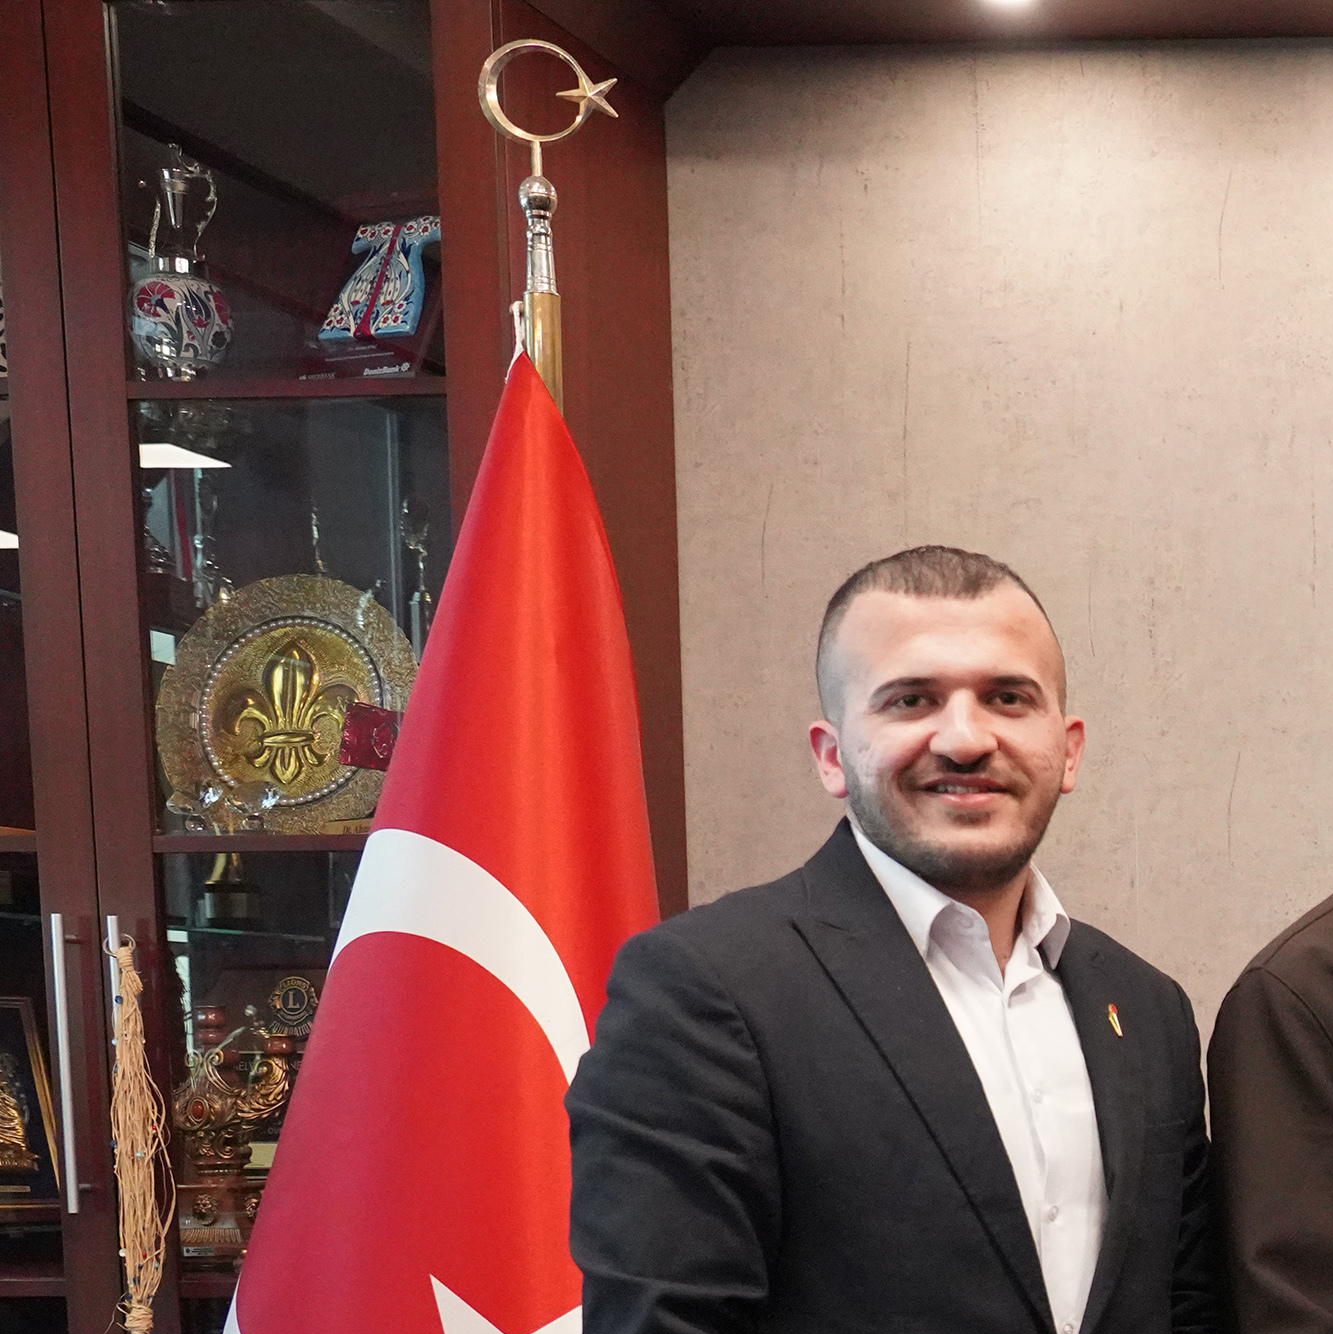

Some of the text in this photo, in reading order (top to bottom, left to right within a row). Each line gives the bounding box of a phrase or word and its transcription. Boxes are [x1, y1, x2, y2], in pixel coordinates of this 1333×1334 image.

[363, 365, 400, 376] DenizBank
[283, 979, 307, 990] LIONS
[288, 991, 300, 1009] L
